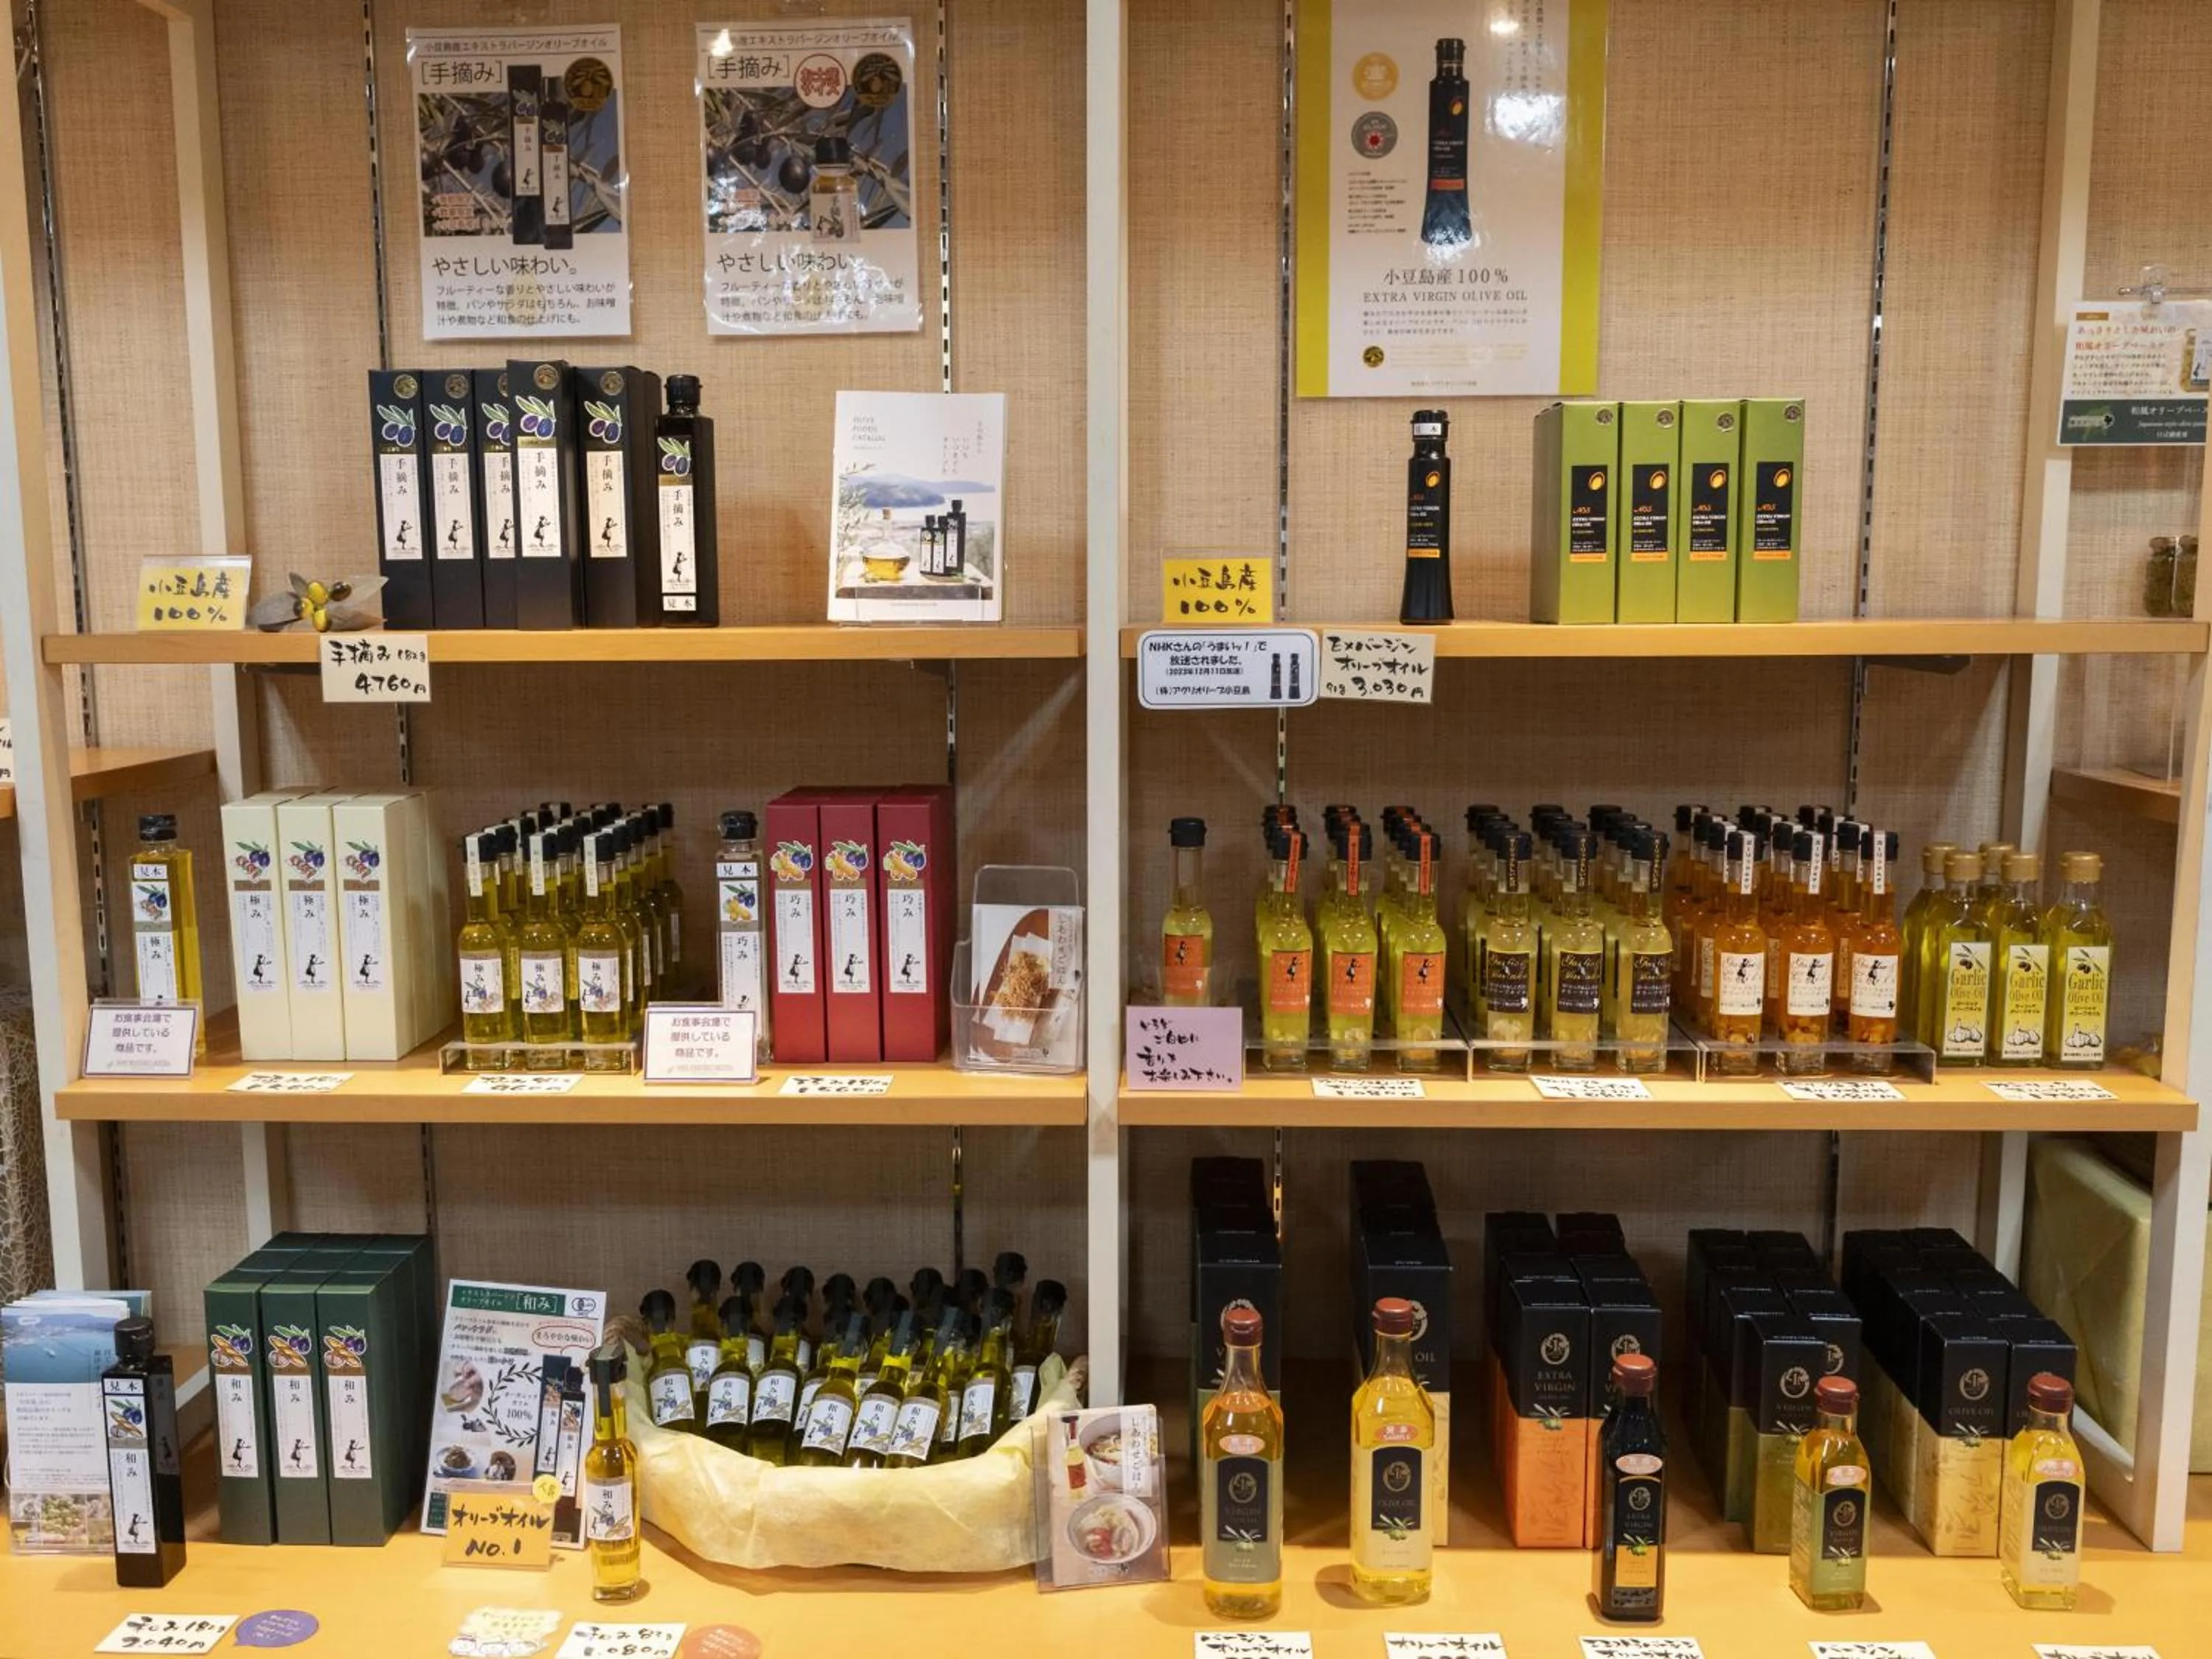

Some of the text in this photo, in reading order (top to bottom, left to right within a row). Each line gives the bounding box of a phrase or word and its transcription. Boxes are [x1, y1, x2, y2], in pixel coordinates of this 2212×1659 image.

[433, 255, 577, 276] やさしい味わい。
[1363, 290, 1528, 302] EXTRA VIRGIN OLIVE OIL
[1173, 563, 1256, 591] 小豆島産
[149, 571, 230, 599] 小豆島産
[1181, 597, 1256, 615] 100%
[154, 605, 227, 623] 100%
[329, 639, 391, 667] 手摘み
[1170, 655, 1242, 666] 放送されました。
[1334, 655, 1429, 675] オリーブオイル
[139, 866, 163, 878] 見本
[722, 865, 752, 876] 見本
[1951, 968, 1987, 986] Garlic
[2010, 971, 2045, 989] Garlic
[2068, 972, 2105, 990] Garlic
[1950, 987, 1971, 999] Olive
[2009, 990, 2030, 1002] Olive
[2067, 991, 2089, 1004] Olive
[112, 1027, 170, 1038] 提供している
[670, 1032, 731, 1043] 提供している
[1415, 1352, 1437, 1364] OIL
[1538, 1370, 1573, 1380] EXTRA
[110, 1380, 139, 1393] 見本
[1534, 1381, 1576, 1393] VIRGIN
[507, 1409, 534, 1421] 100%
[451, 1504, 550, 1528] オリーブオイル
[1206, 1643, 1310, 1655] オリーブオイル
[1388, 1635, 1504, 1652] オリーブオイル
